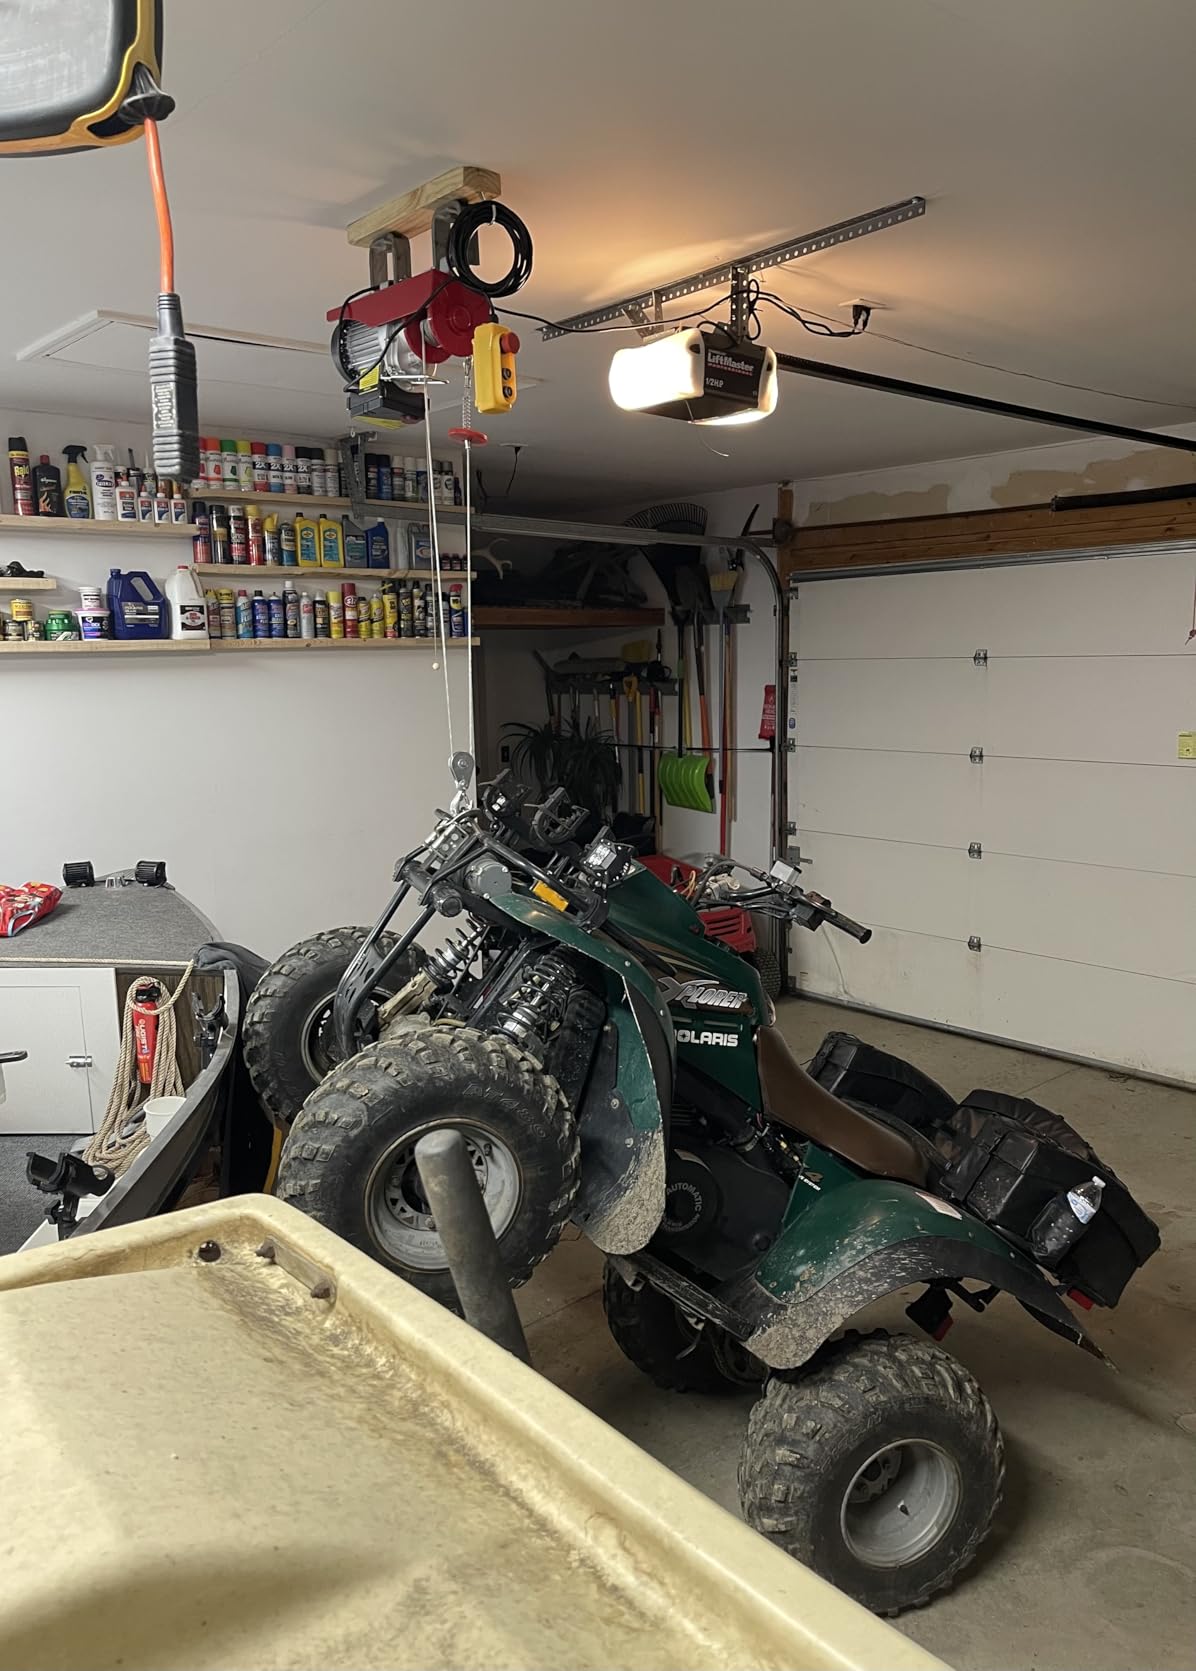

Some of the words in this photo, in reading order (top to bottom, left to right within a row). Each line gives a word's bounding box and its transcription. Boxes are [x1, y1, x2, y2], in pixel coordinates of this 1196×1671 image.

[708, 353, 753, 371] LiftMaster
[674, 1029, 738, 1047] OLARIS
[667, 1182, 702, 1212] AUTOMATIC
